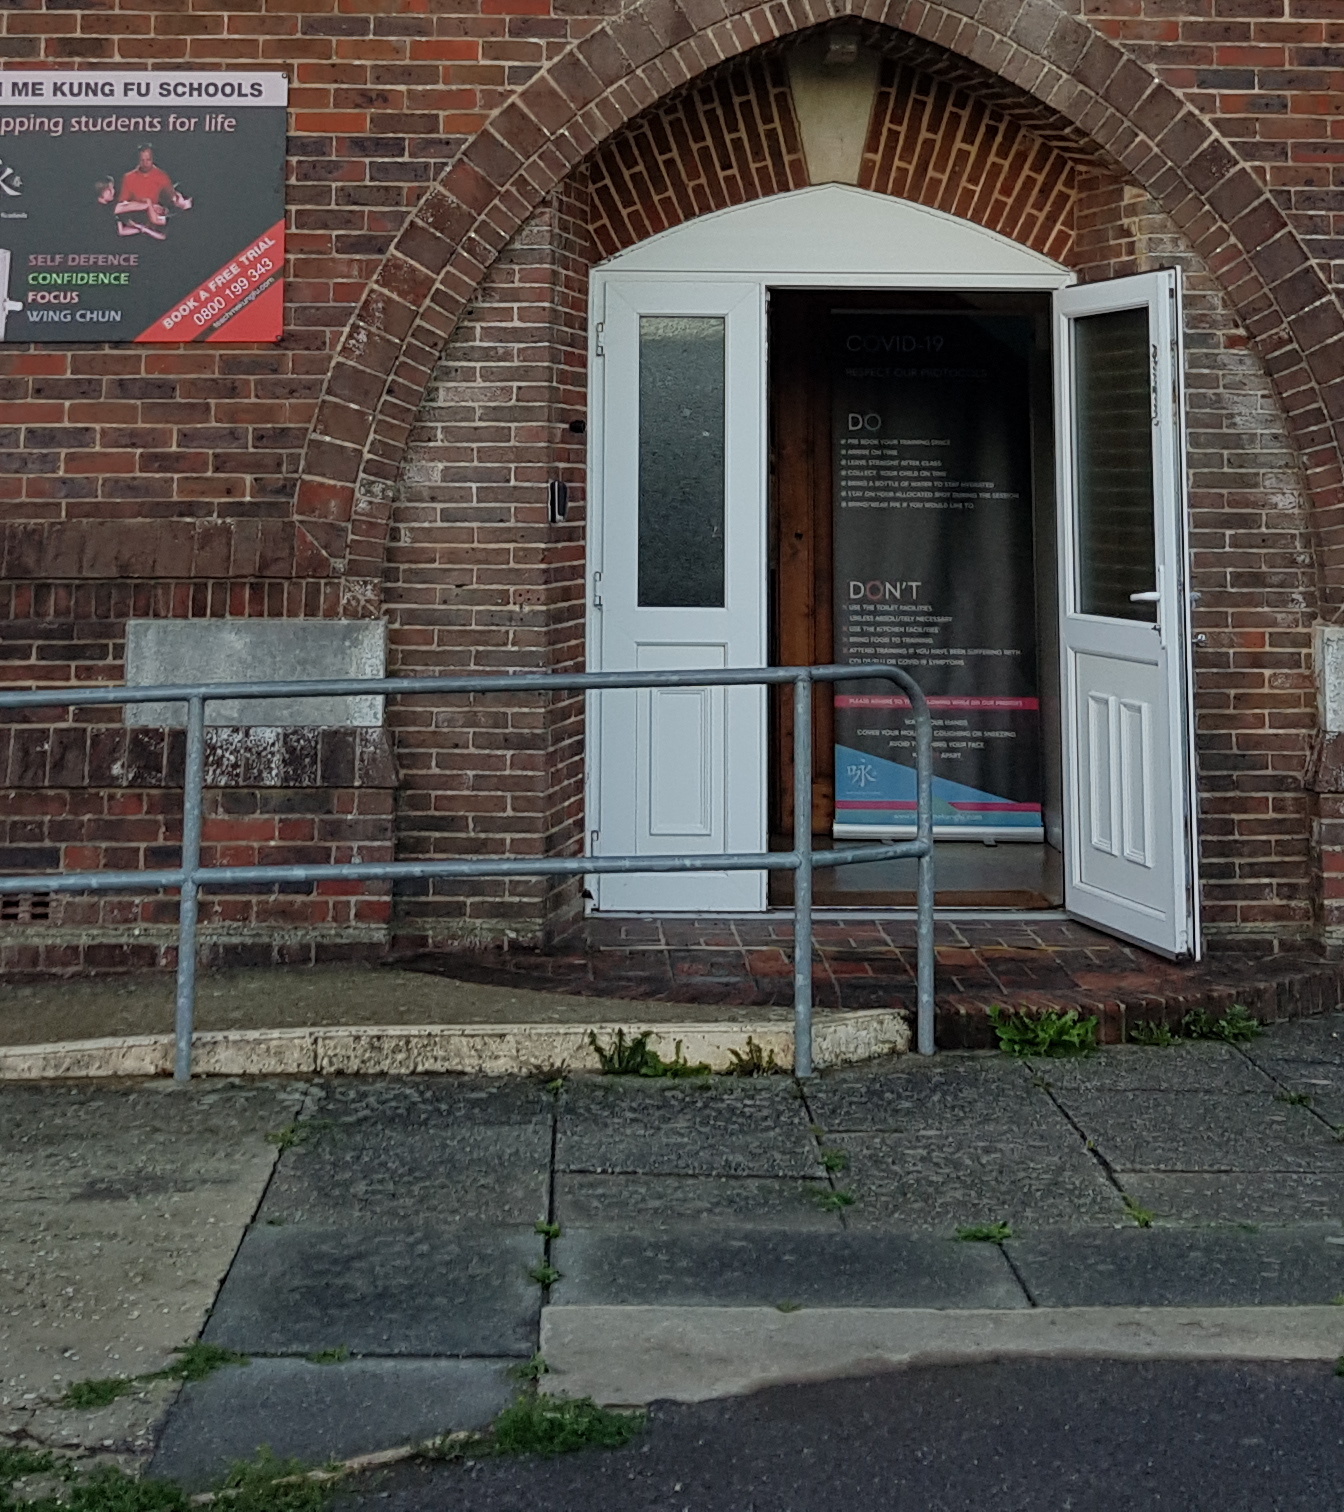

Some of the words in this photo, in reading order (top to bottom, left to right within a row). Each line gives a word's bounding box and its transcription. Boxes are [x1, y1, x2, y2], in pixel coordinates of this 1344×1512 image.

[11, 81, 45, 97] ME
[52, 81, 115, 97] KUNG
[123, 81, 151, 97] FU
[158, 81, 264, 97] SCHOOLS
[70, 114, 162, 132] students
[168, 114, 199, 132] for
[205, 114, 237, 132] life
[28, 254, 64, 266] SELF
[67, 254, 139, 266] DEFENCE
[27, 272, 130, 285] CONFIDENCE
[162, 297, 200, 330] BOOK
[198, 290, 211, 302] A
[208, 263, 241, 292] FREE
[238, 237, 276, 265] TRIAL
[27, 291, 80, 304] FOCUS
[193, 296, 226, 326] 0800
[224, 277, 249, 299] 199
[247, 257, 273, 281] 343
[26, 310, 72, 322] WING
[75, 310, 122, 322] CHUN
[846, 335, 944, 352] COVID-19
[848, 413, 882, 431] DO
[849, 580, 922, 600] DON'T
